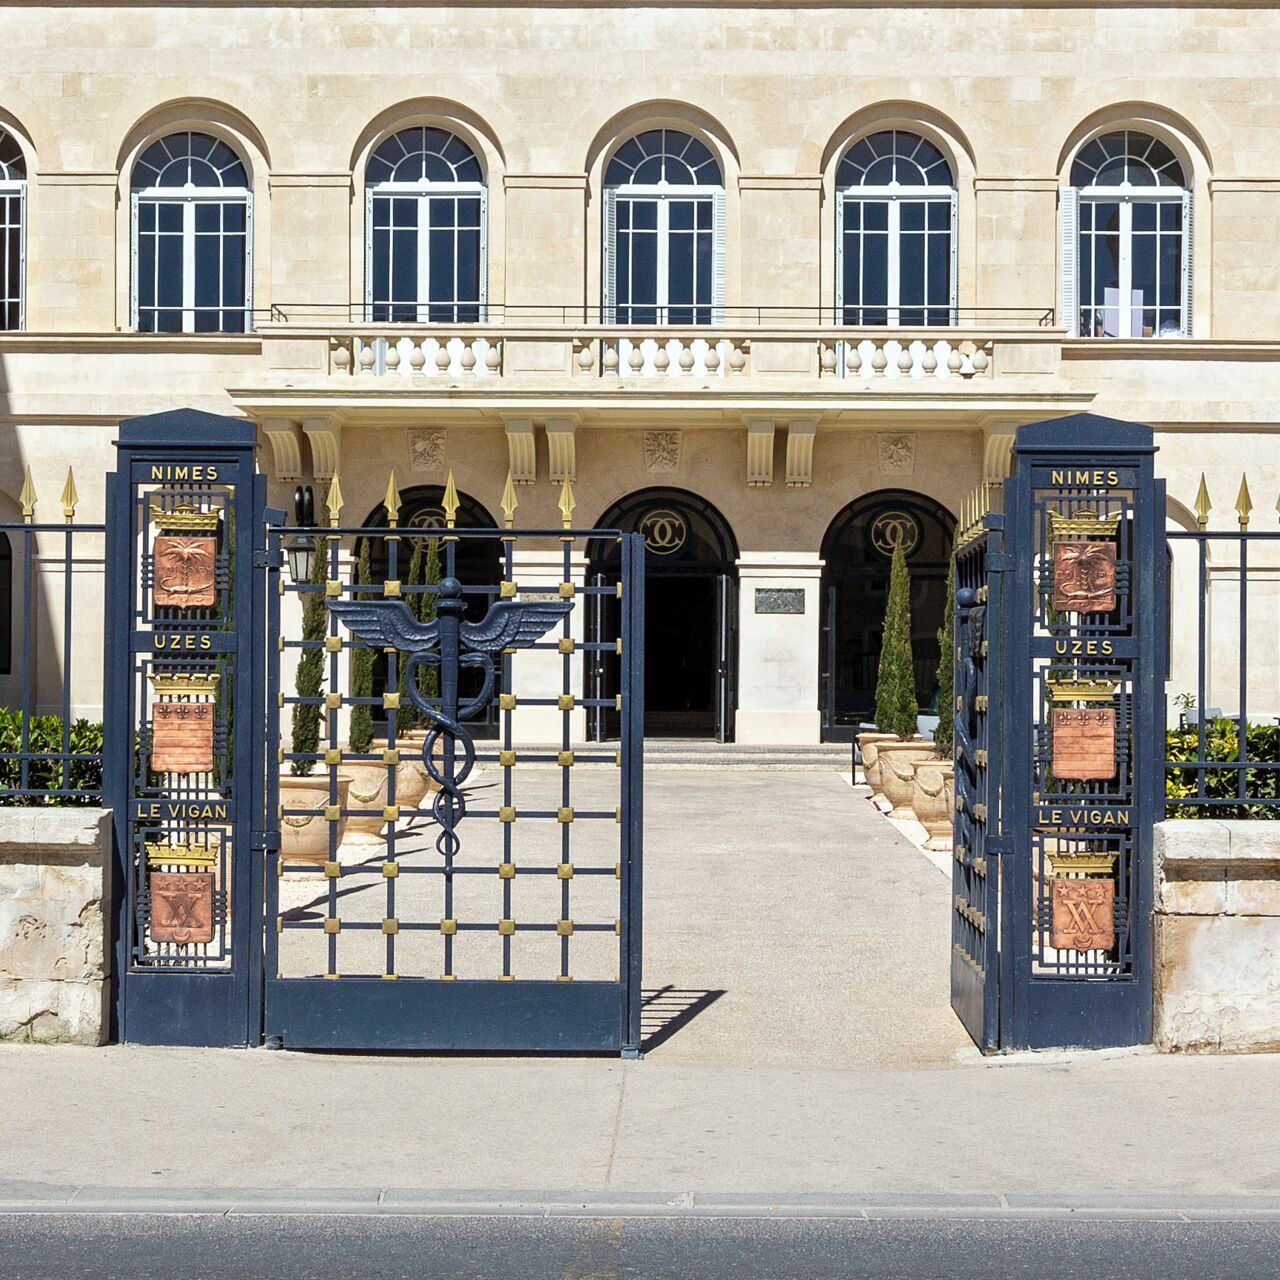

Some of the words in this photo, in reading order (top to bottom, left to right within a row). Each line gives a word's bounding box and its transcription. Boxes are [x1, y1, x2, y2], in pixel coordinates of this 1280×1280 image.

[151, 465, 218, 481] NIMES
[1051, 470, 1119, 486] NIMES
[154, 634, 212, 649] UZES
[1055, 640, 1113, 655] UZES
[136, 803, 161, 818] LE
[167, 803, 227, 819] VIGAN
[1038, 809, 1063, 824] LE
[1069, 809, 1129, 825] VIGAN
